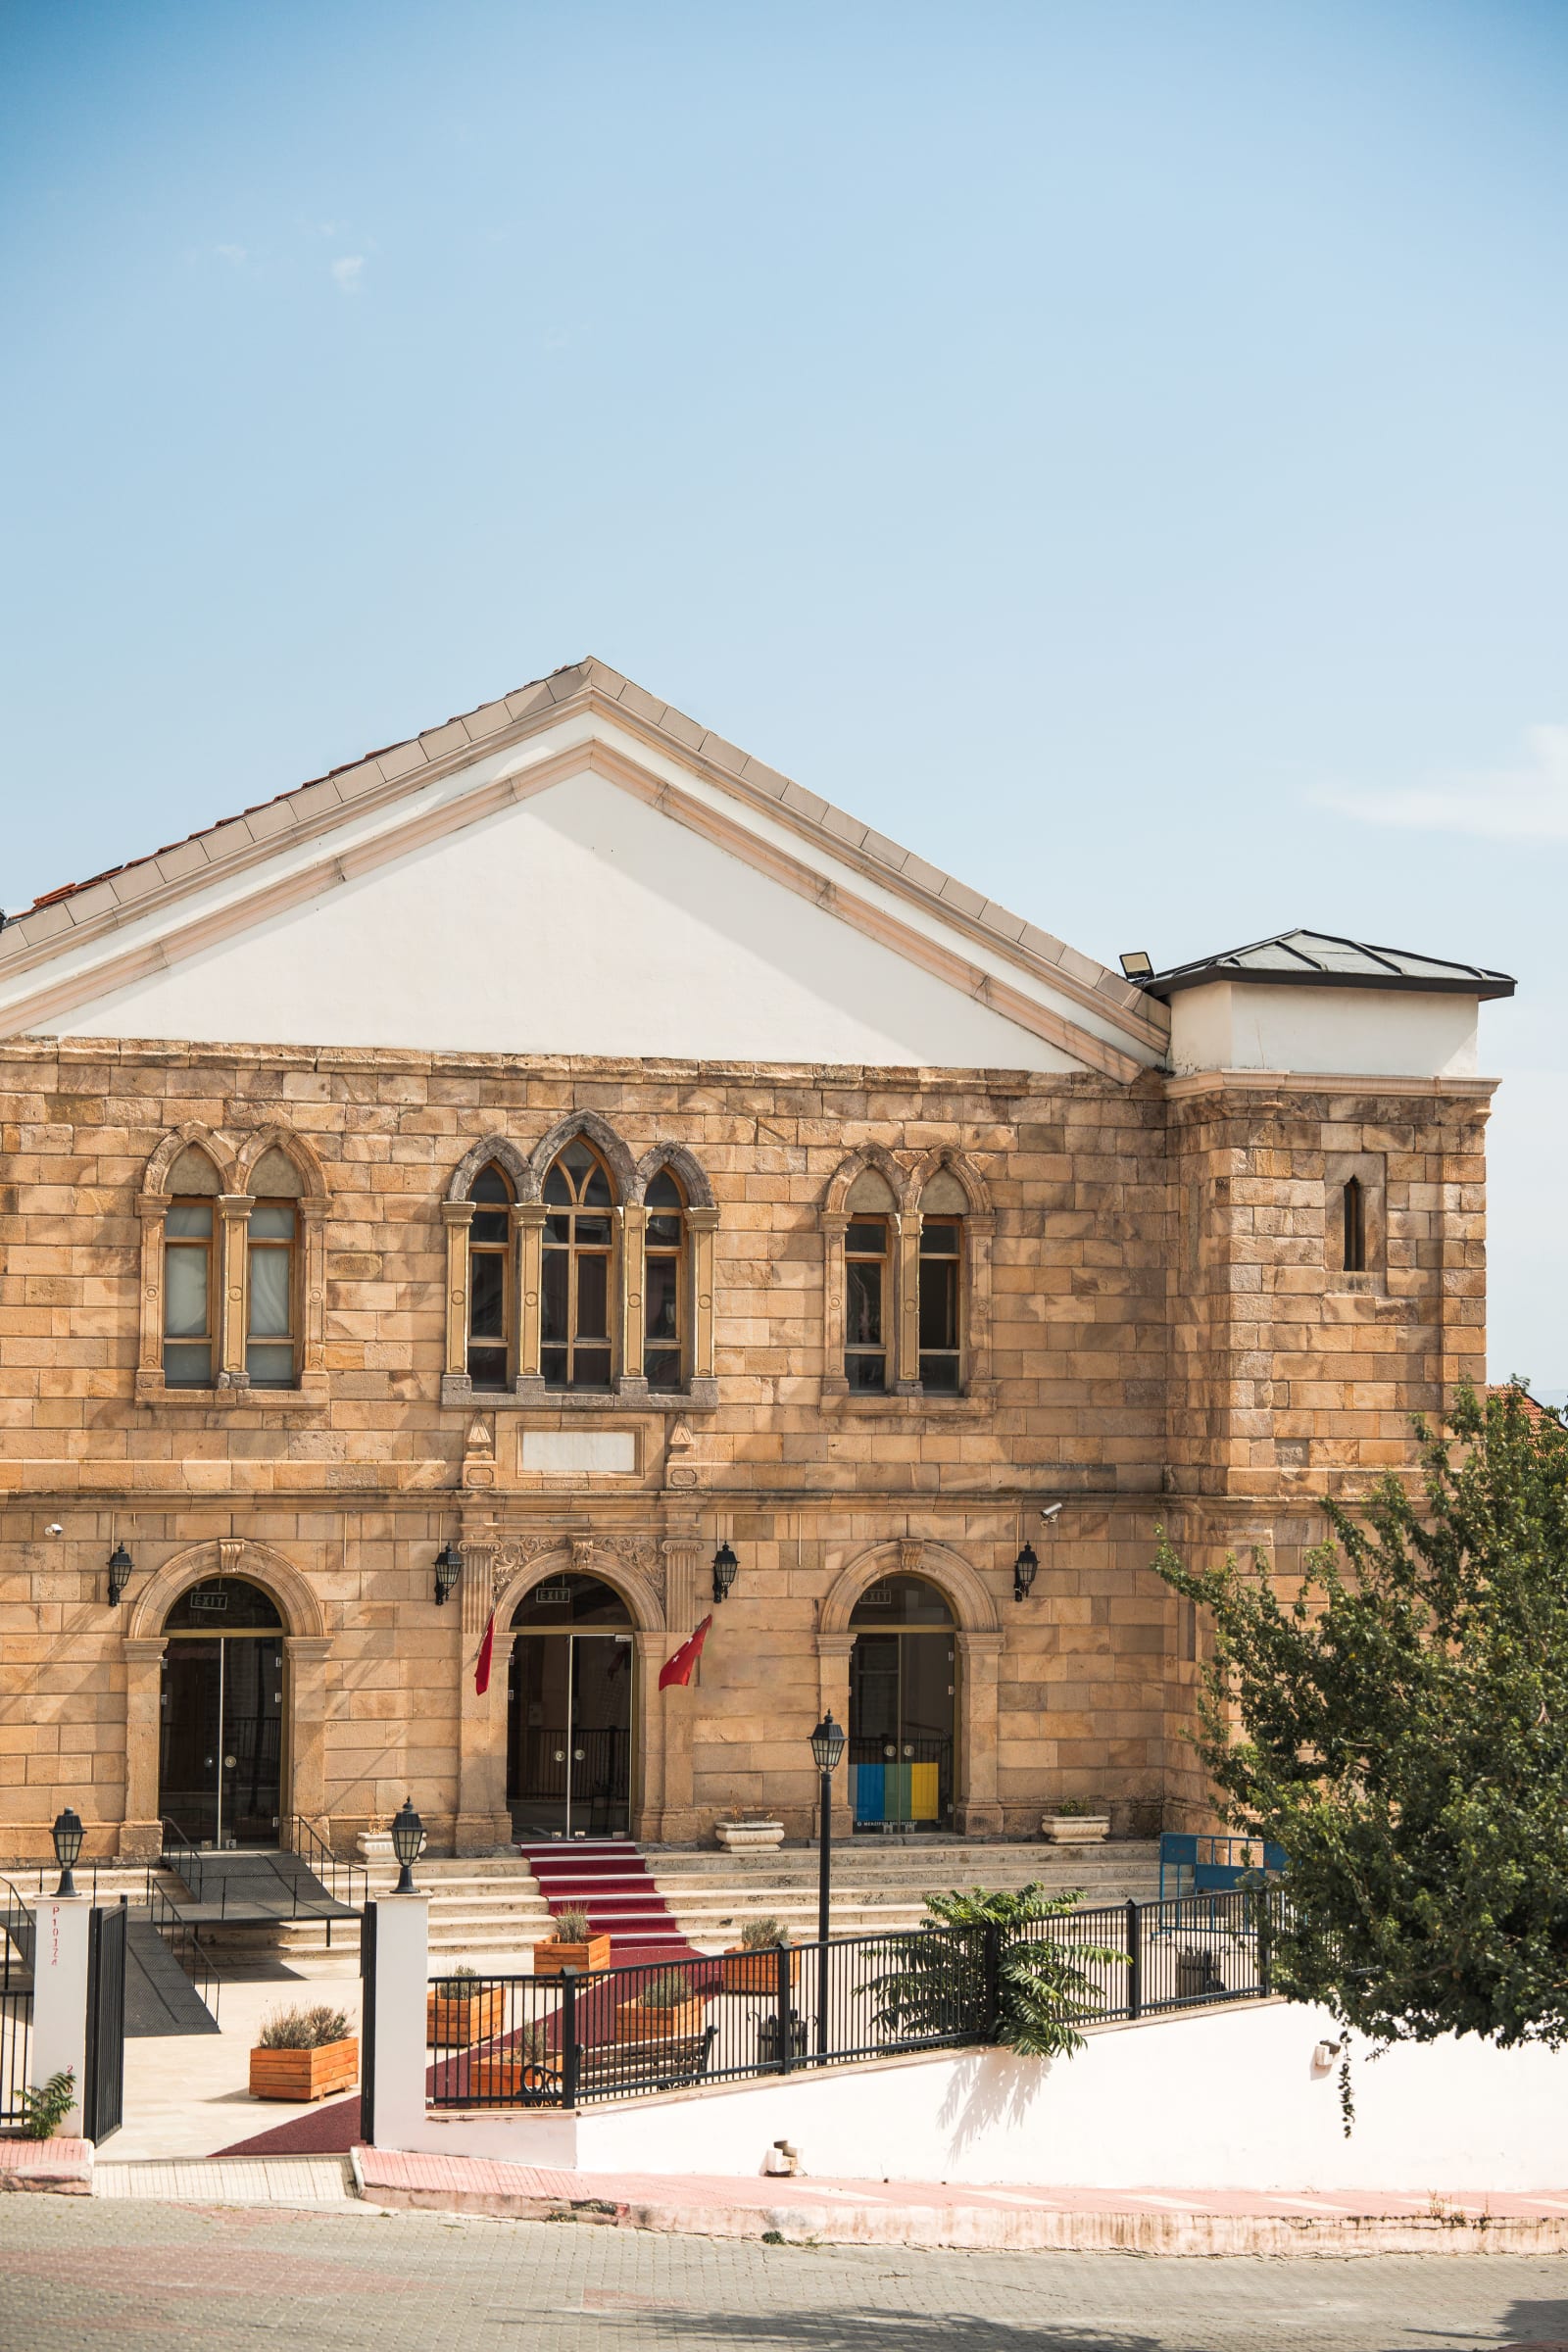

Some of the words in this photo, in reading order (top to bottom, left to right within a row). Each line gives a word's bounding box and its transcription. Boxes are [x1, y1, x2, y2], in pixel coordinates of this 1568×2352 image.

[540, 1591, 567, 1600] EXIT
[862, 1592, 889, 1602] EXIT
[195, 1595, 223, 1607] EXIT
